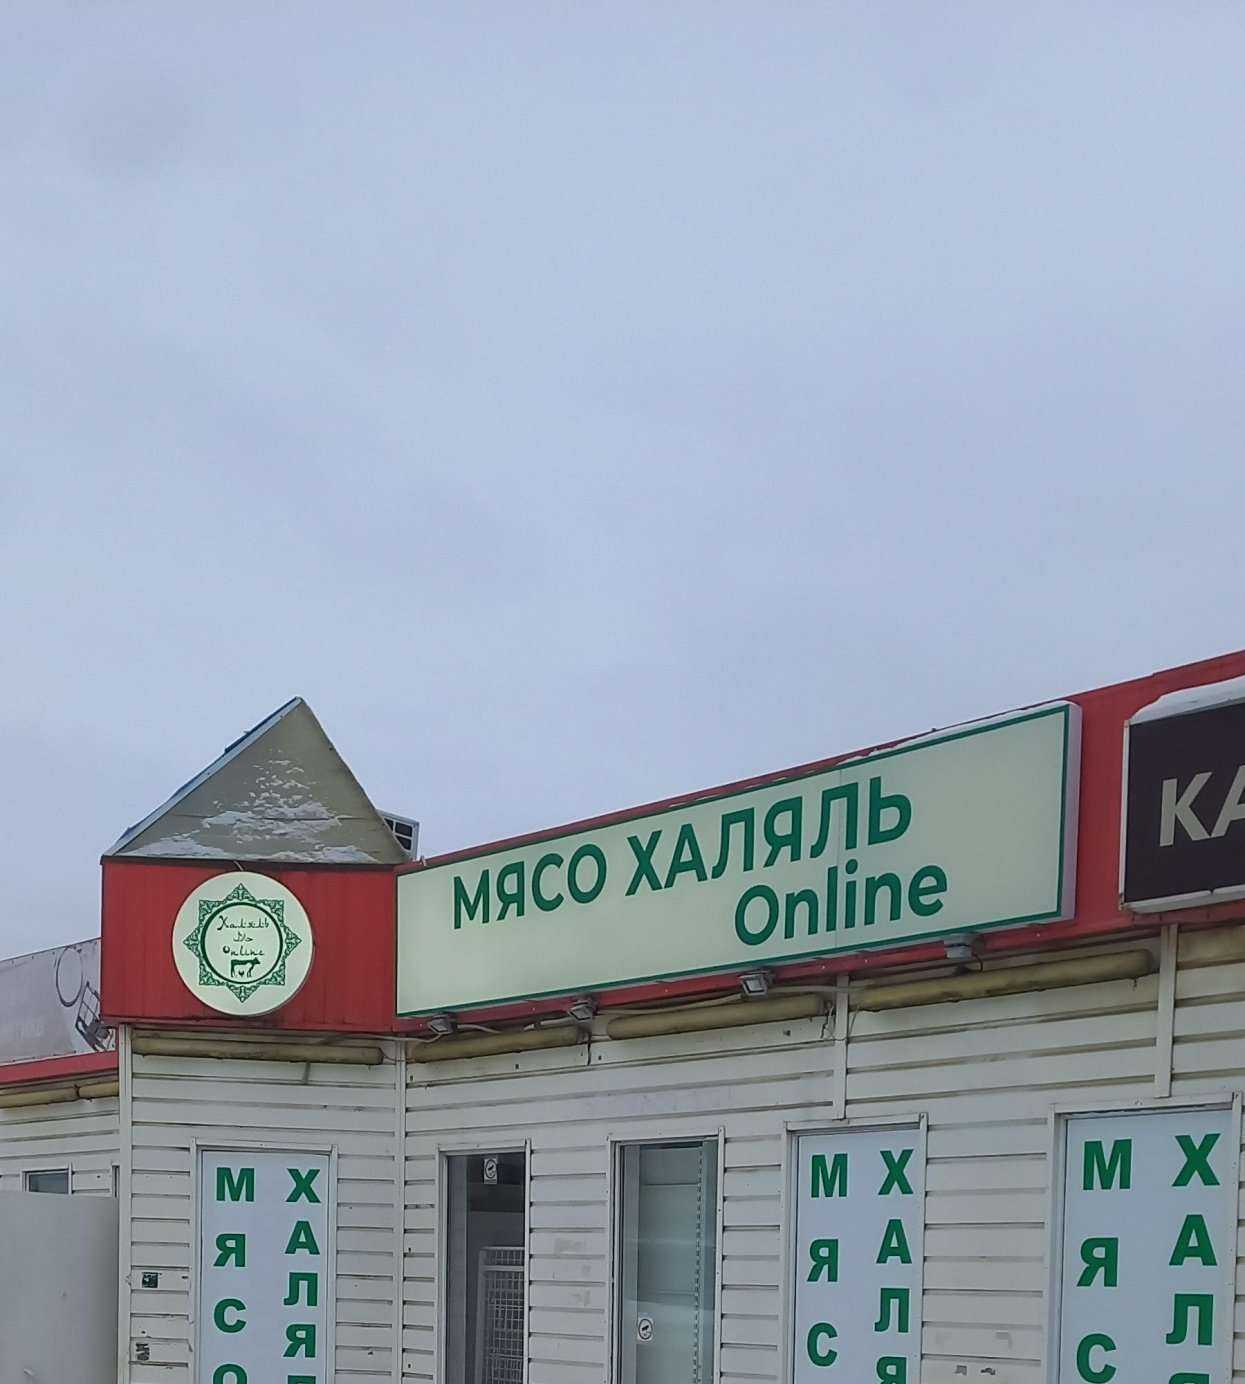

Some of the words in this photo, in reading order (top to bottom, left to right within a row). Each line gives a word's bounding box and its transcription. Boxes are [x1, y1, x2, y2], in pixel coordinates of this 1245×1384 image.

[453, 842, 607, 930] МЯСО
[626, 776, 913, 898] ХАЛЯЛЬ
[734, 858, 948, 947] Online
